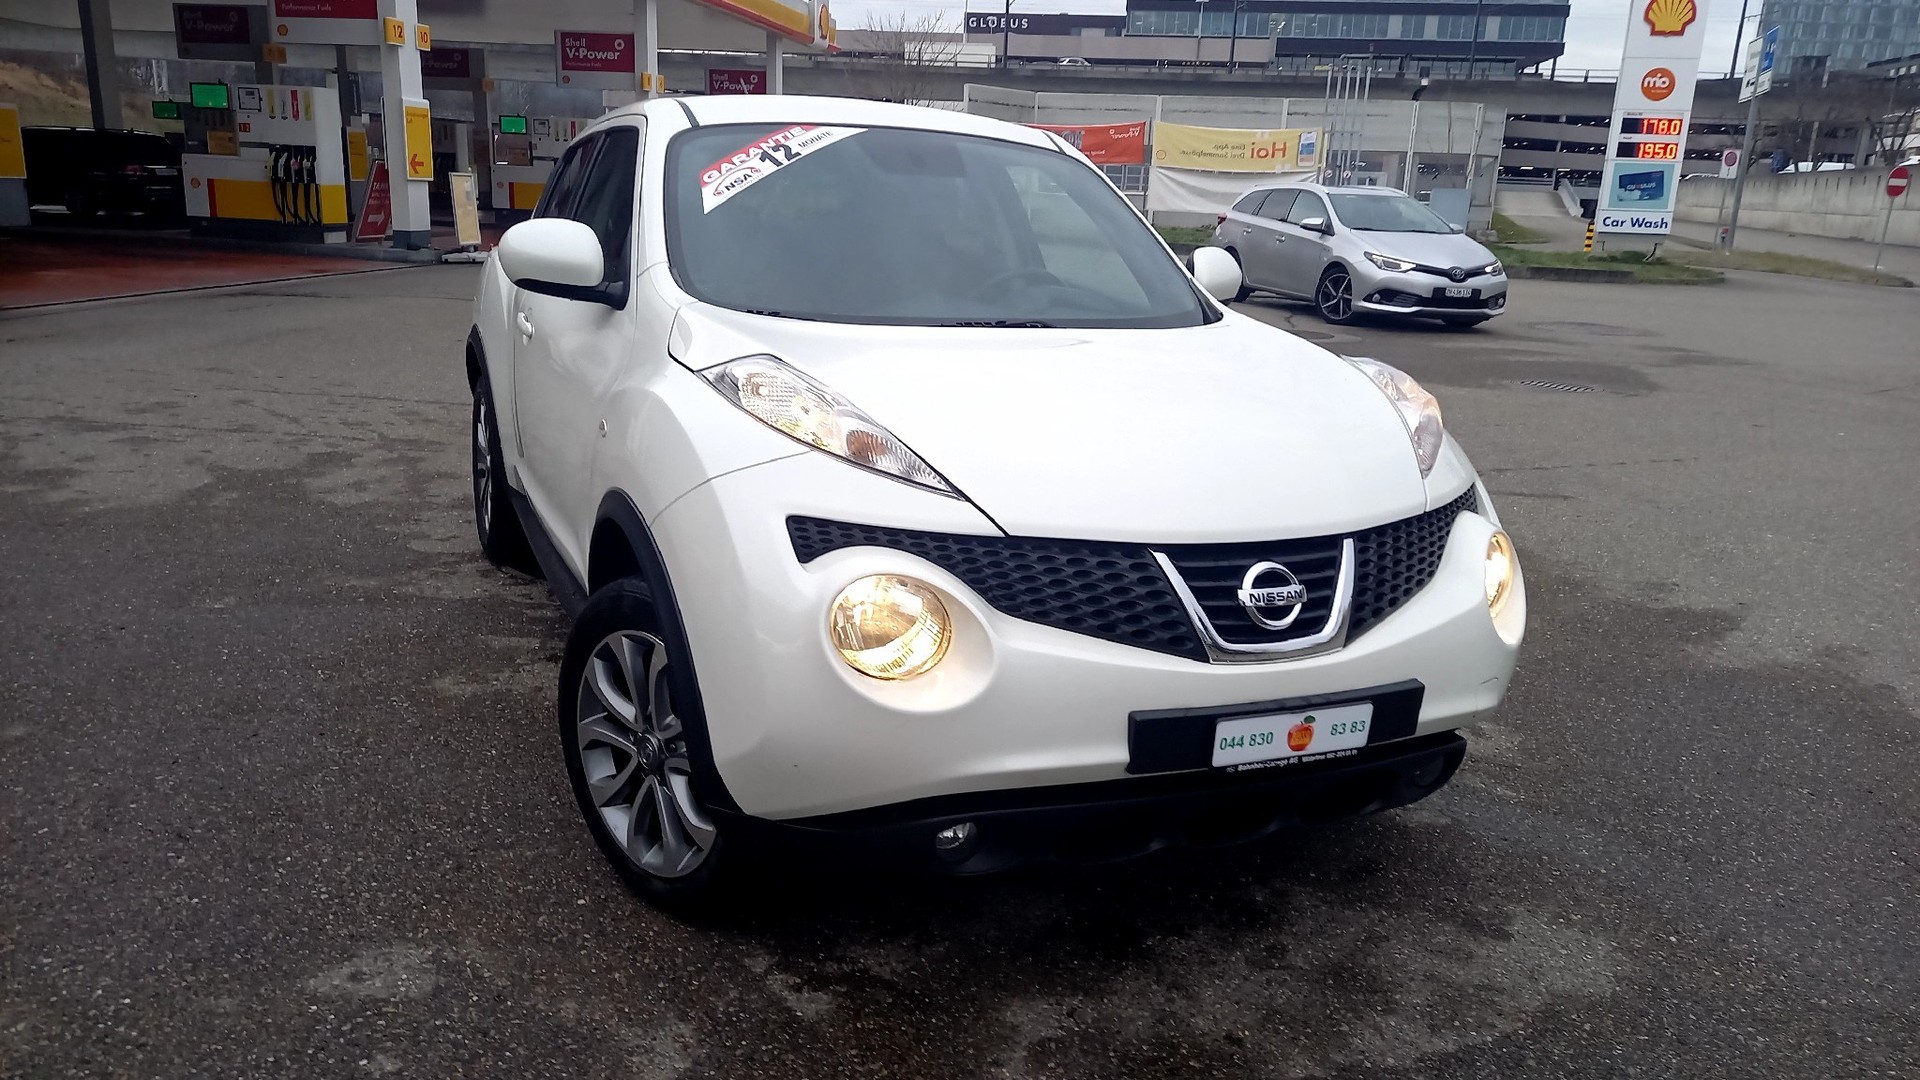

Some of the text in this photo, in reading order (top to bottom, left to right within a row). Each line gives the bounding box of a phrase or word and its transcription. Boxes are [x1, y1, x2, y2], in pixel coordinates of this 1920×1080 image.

[393, 25, 403, 38] 12
[420, 31, 429, 43] 10
[565, 38, 586, 47] Shell
[703, 126, 807, 183] GARANTIE
[760, 144, 801, 167] 12
[725, 173, 753, 191] NSA
[1602, 216, 1668, 229] Car Wash
[1249, 590, 1303, 603] NISSAN
[1219, 735, 1244, 750] 044
[1249, 731, 1274, 746] 830
[1330, 723, 1346, 736] 83
[1350, 720, 1366, 733] 83
